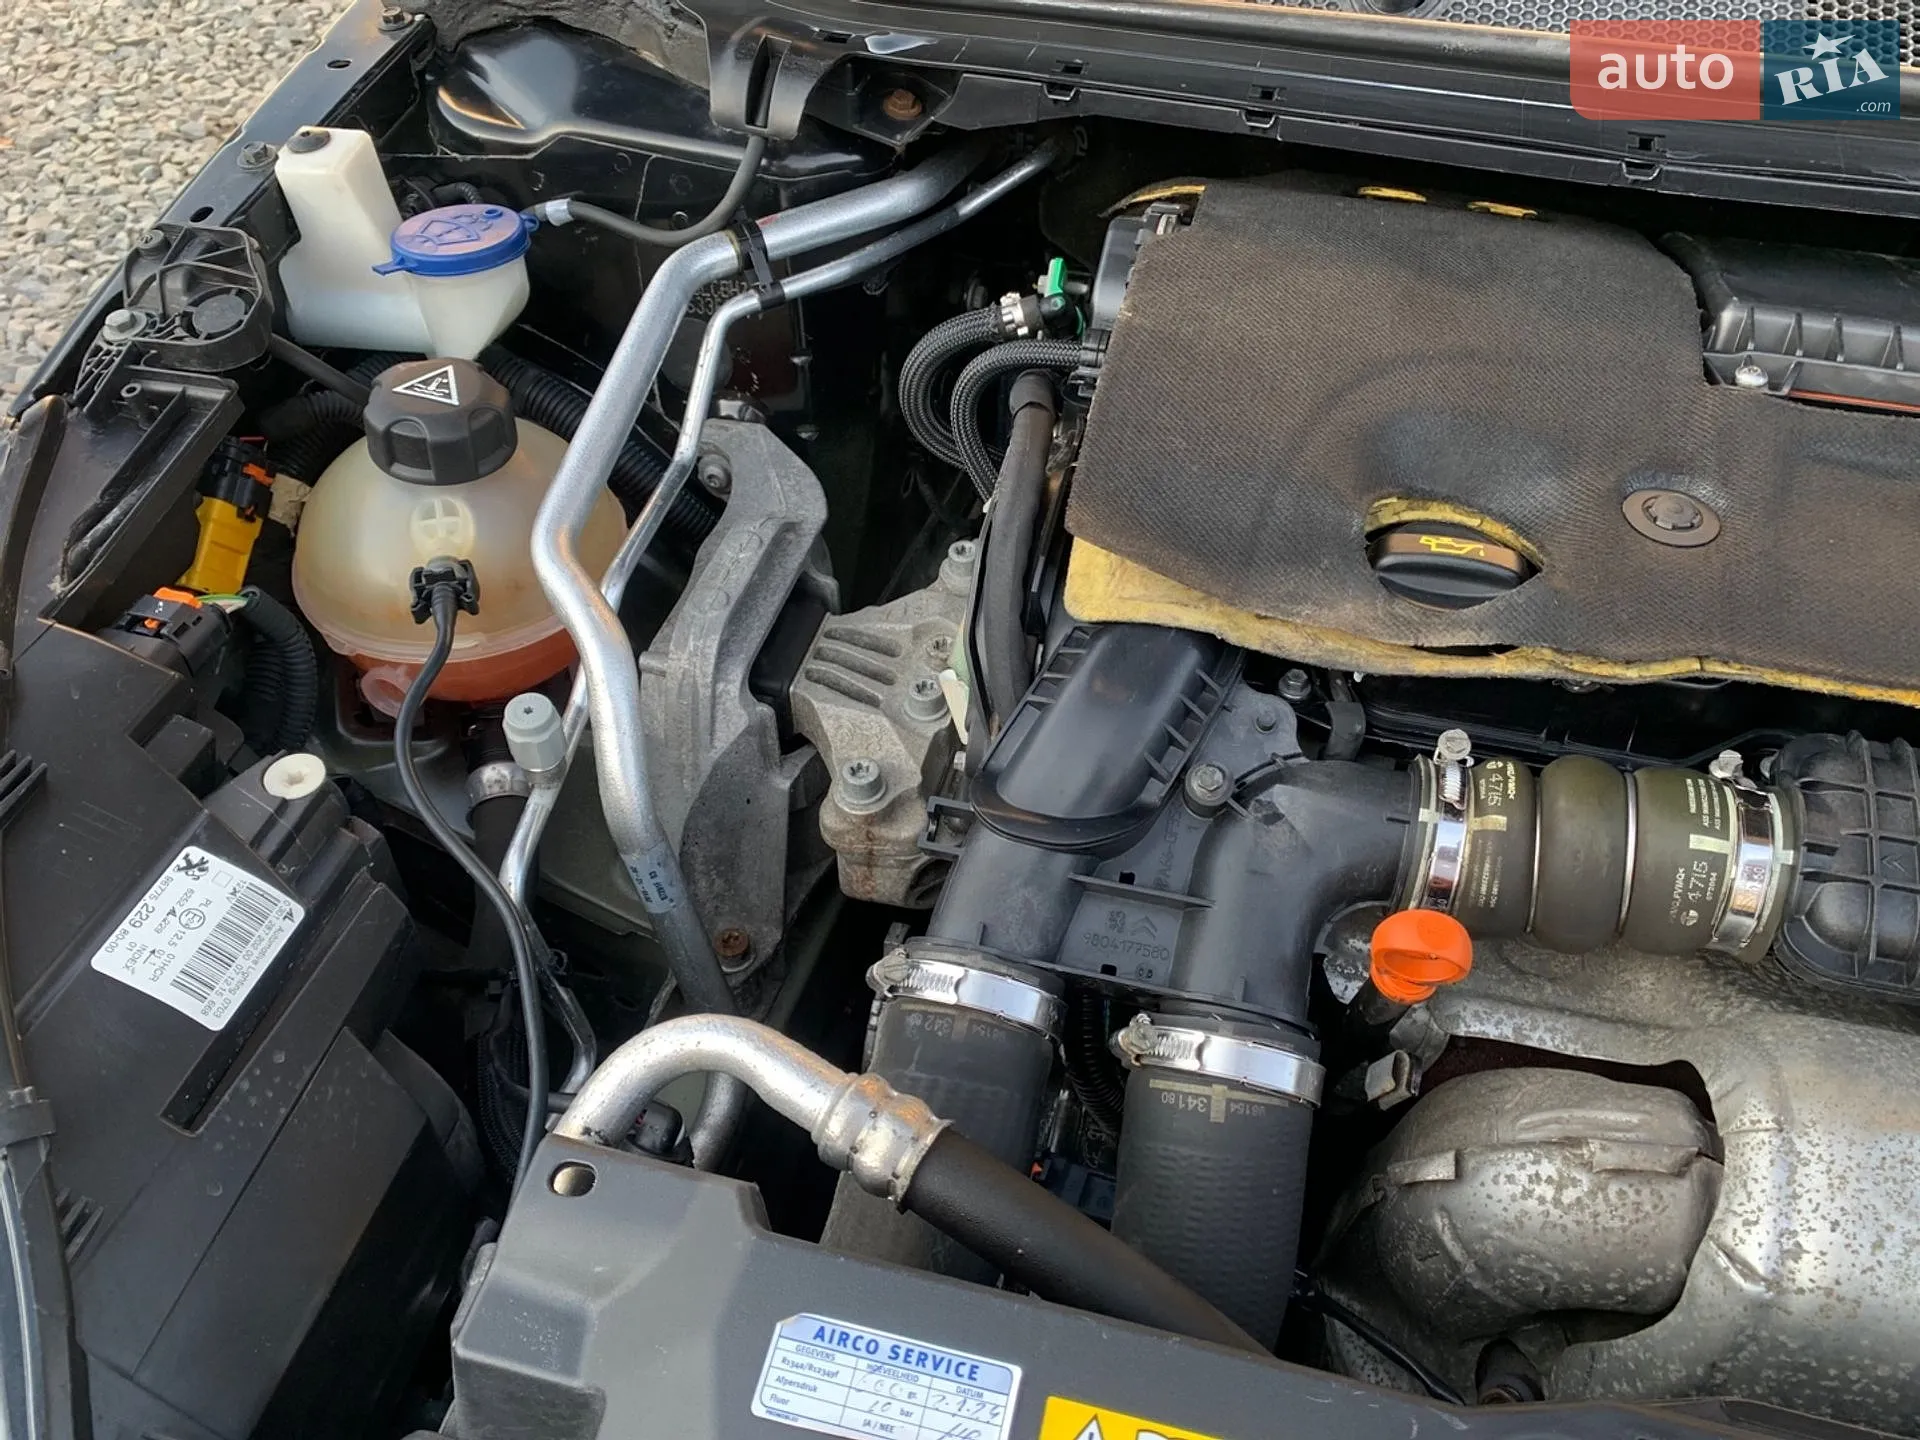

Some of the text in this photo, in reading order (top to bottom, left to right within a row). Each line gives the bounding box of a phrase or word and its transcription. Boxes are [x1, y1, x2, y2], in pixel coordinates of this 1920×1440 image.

[1686, 859, 1709, 903] 4715
[127, 902, 155, 929] 229
[197, 897, 212, 910] PL
[250, 925, 286, 967] Automotive
[226, 964, 256, 996] Lighting
[211, 996, 232, 1018] 0703
[796, 1345, 836, 1361] GEGEVENS
[956, 1386, 984, 1398] DATUM
[813, 1326, 980, 1381] AIRCO SERVICE
[776, 1376, 913, 1417] Afpersdruk bar
